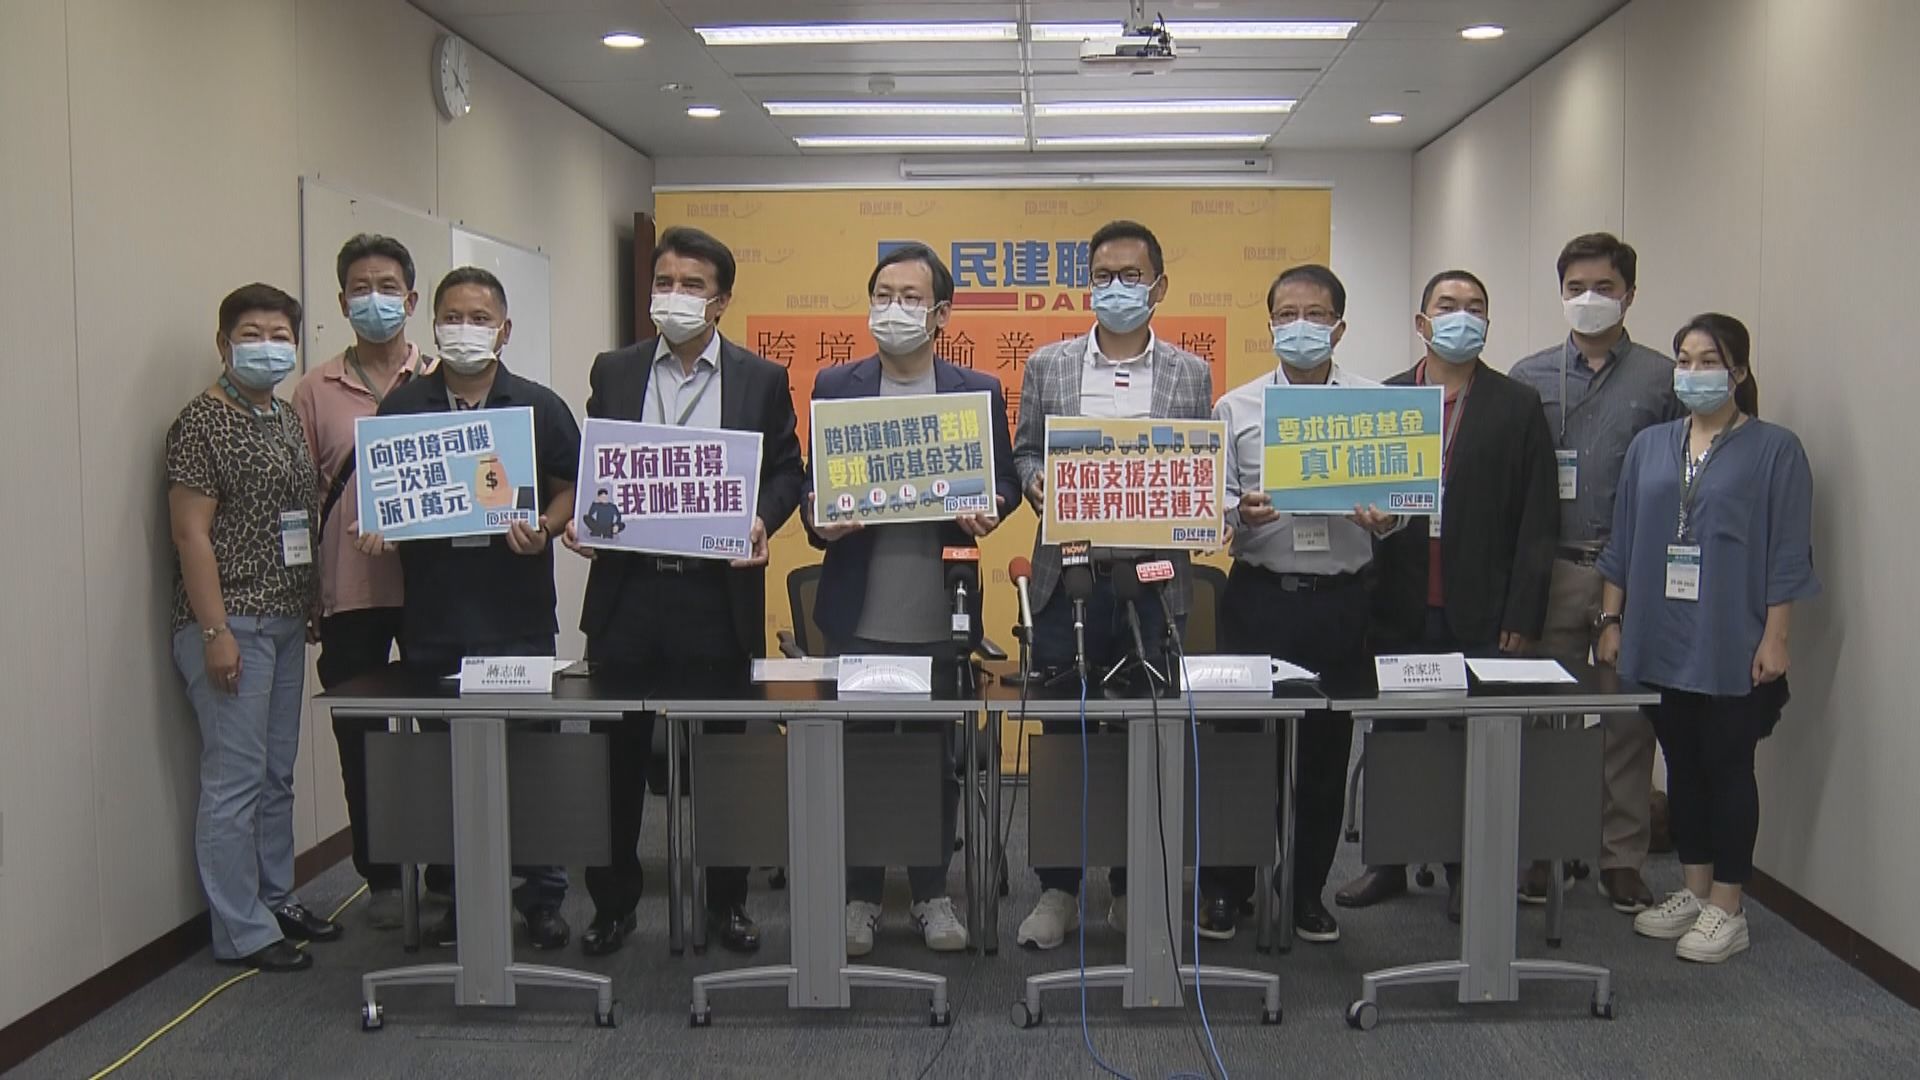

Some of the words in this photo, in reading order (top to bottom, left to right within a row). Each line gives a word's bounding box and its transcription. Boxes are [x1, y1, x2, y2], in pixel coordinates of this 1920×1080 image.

[1025, 292, 1091, 311] DA
[824, 408, 980, 456] 跨境運輸業界苦撐
[1278, 408, 1425, 444] 要求抗疫基金
[369, 423, 491, 469] 向跨境司機
[598, 443, 724, 479] 政府唔撐
[1300, 441, 1424, 481] 真「補漏」
[375, 460, 447, 493] 一次過
[827, 441, 984, 489] 要求抗疫基金支援
[1056, 458, 1214, 490] 政府支援去咗邊
[378, 486, 469, 526] 派1萬元
[617, 479, 743, 515] 我哋點捱
[1057, 490, 1214, 521] 得業界叫苦連天
